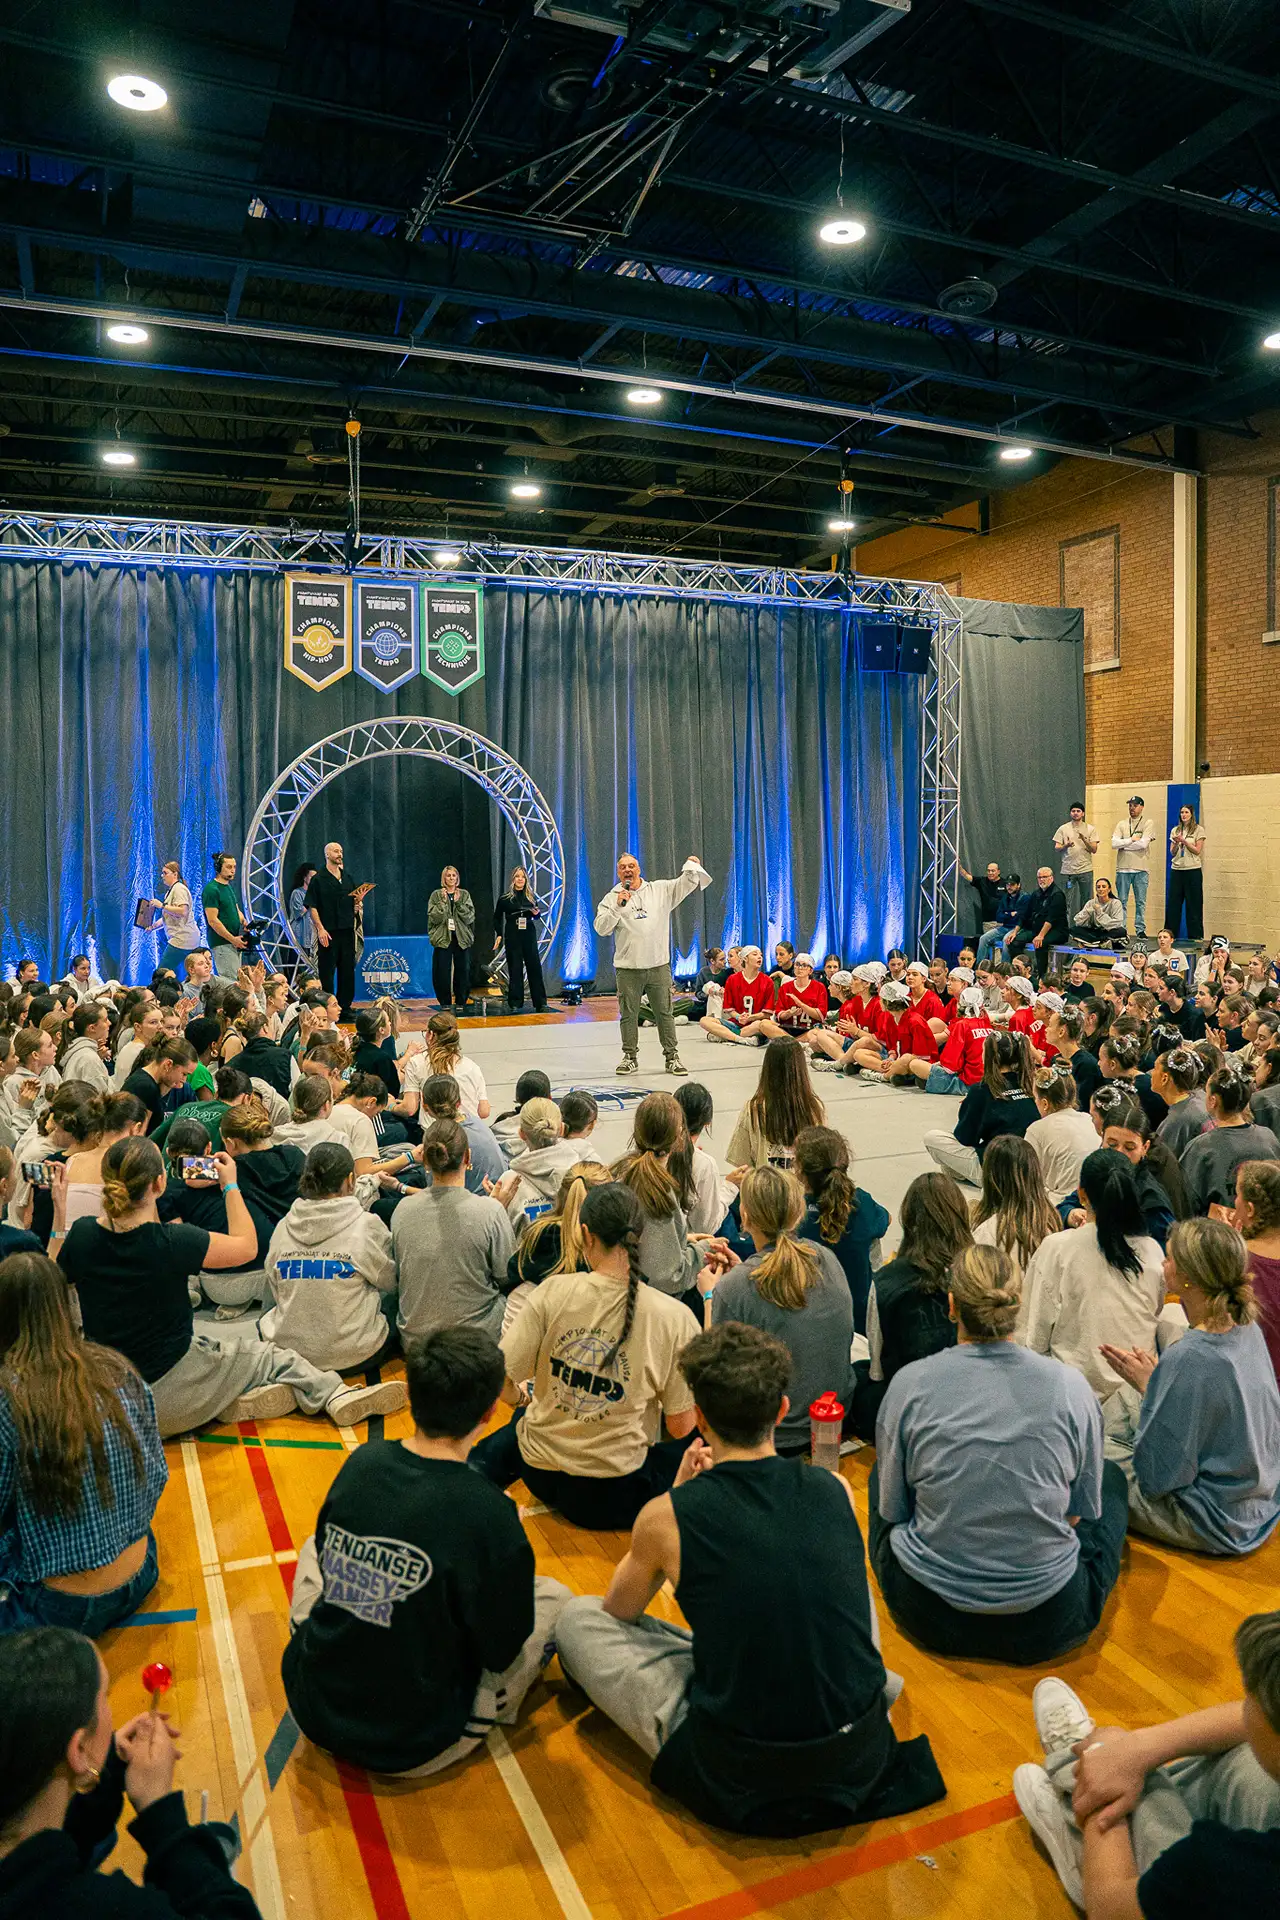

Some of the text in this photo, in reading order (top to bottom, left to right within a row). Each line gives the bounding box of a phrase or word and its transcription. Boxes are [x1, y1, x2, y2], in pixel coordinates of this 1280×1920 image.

[297, 595, 340, 607] TEMPO
[366, 600, 407, 610] TEMPO
[432, 603, 472, 614] TEMPO
[297, 617, 340, 635] CHAMPIONS
[366, 621, 408, 638] CHAMPIONS
[432, 624, 473, 641] CHAMPIONS
[302, 652, 333, 664] HIP-HOP
[374, 656, 400, 666] TEMPO
[435, 654, 471, 668] TECHNIQUE
[361, 971, 411, 984] TEMPO
[743, 996, 754, 1014] 9
[179, 1106, 222, 1122] obey
[275, 1259, 358, 1280] TEMPO
[549, 1356, 626, 1402] TEMPO
[326, 1528, 421, 1583] TENDANSE
